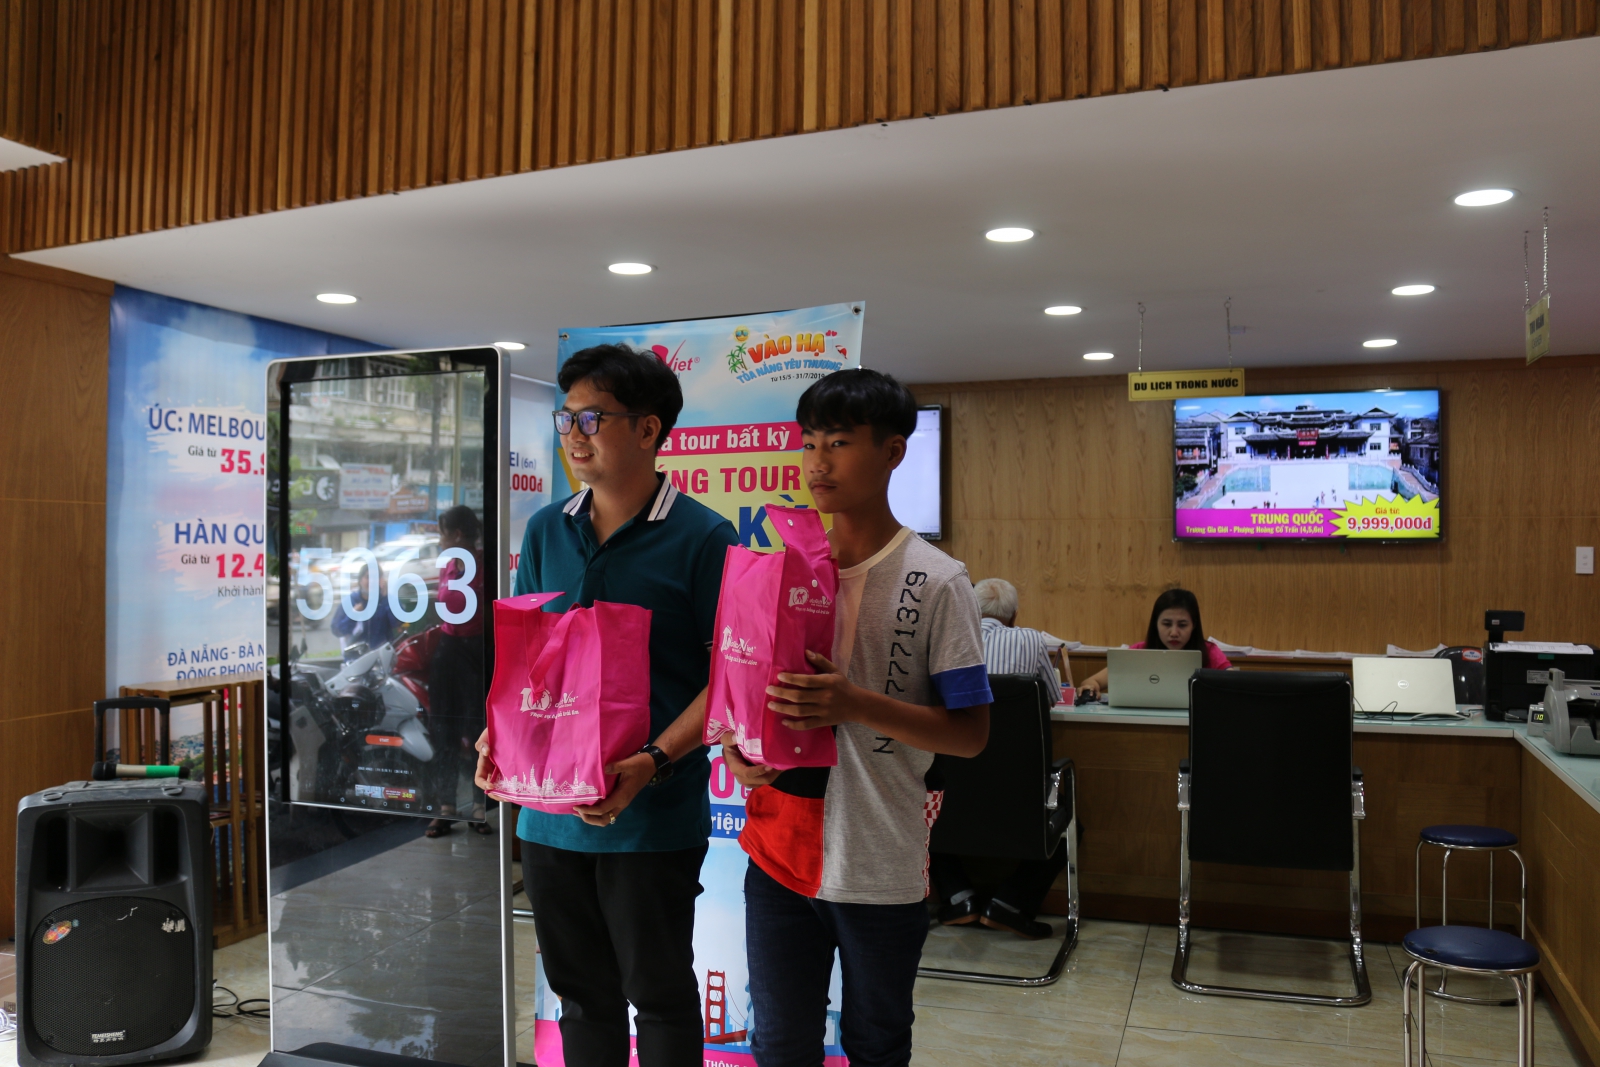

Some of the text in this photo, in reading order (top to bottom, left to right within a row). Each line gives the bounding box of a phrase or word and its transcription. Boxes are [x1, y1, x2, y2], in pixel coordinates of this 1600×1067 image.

[747, 333, 826, 363] VÀO HẠ
[736, 370, 757, 384] TÒA
[784, 358, 802, 370] YÊU
[1134, 377, 1239, 392] DU LỊCH TRONG NƯỚC
[148, 403, 264, 441] ÚC: MELBOU
[188, 445, 204, 457] Giá
[658, 426, 790, 452] a tour bất kỳ
[657, 464, 801, 494] NG TOUR
[739, 494, 809, 547] K
[1207, 526, 1216, 534] Gia
[1250, 509, 1324, 525] TRUNG QUỐC
[1347, 517, 1432, 532] 9,999,000đ
[174, 518, 264, 547] HÀN QU
[181, 553, 197, 565] Giá
[217, 585, 241, 597] Khởi
[296, 547, 478, 625] 5063
[885, 570, 928, 695] 7771379
[167, 648, 187, 667] ĐÀ
[191, 643, 228, 664] NẴNG
[239, 642, 255, 659] BÀ
